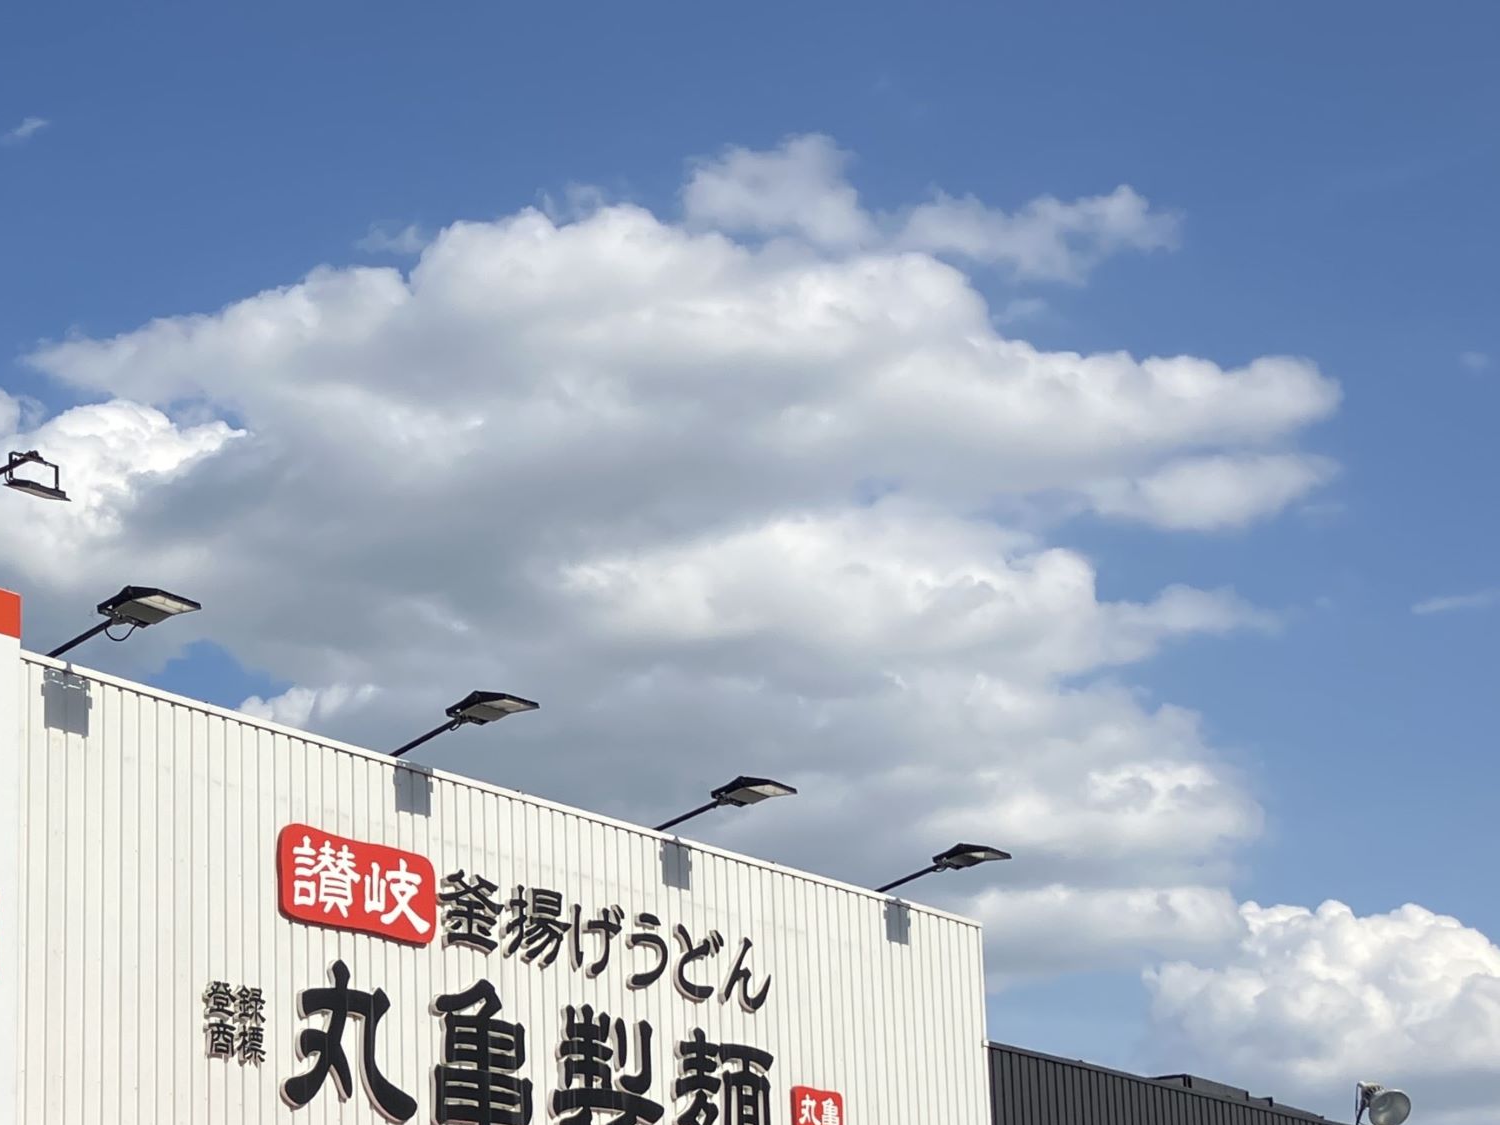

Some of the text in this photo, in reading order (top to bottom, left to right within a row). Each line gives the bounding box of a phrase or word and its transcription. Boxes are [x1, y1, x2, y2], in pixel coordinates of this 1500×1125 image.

[292, 836, 432, 936] 讃岐
[439, 868, 772, 1014] 釜揚げうどん
